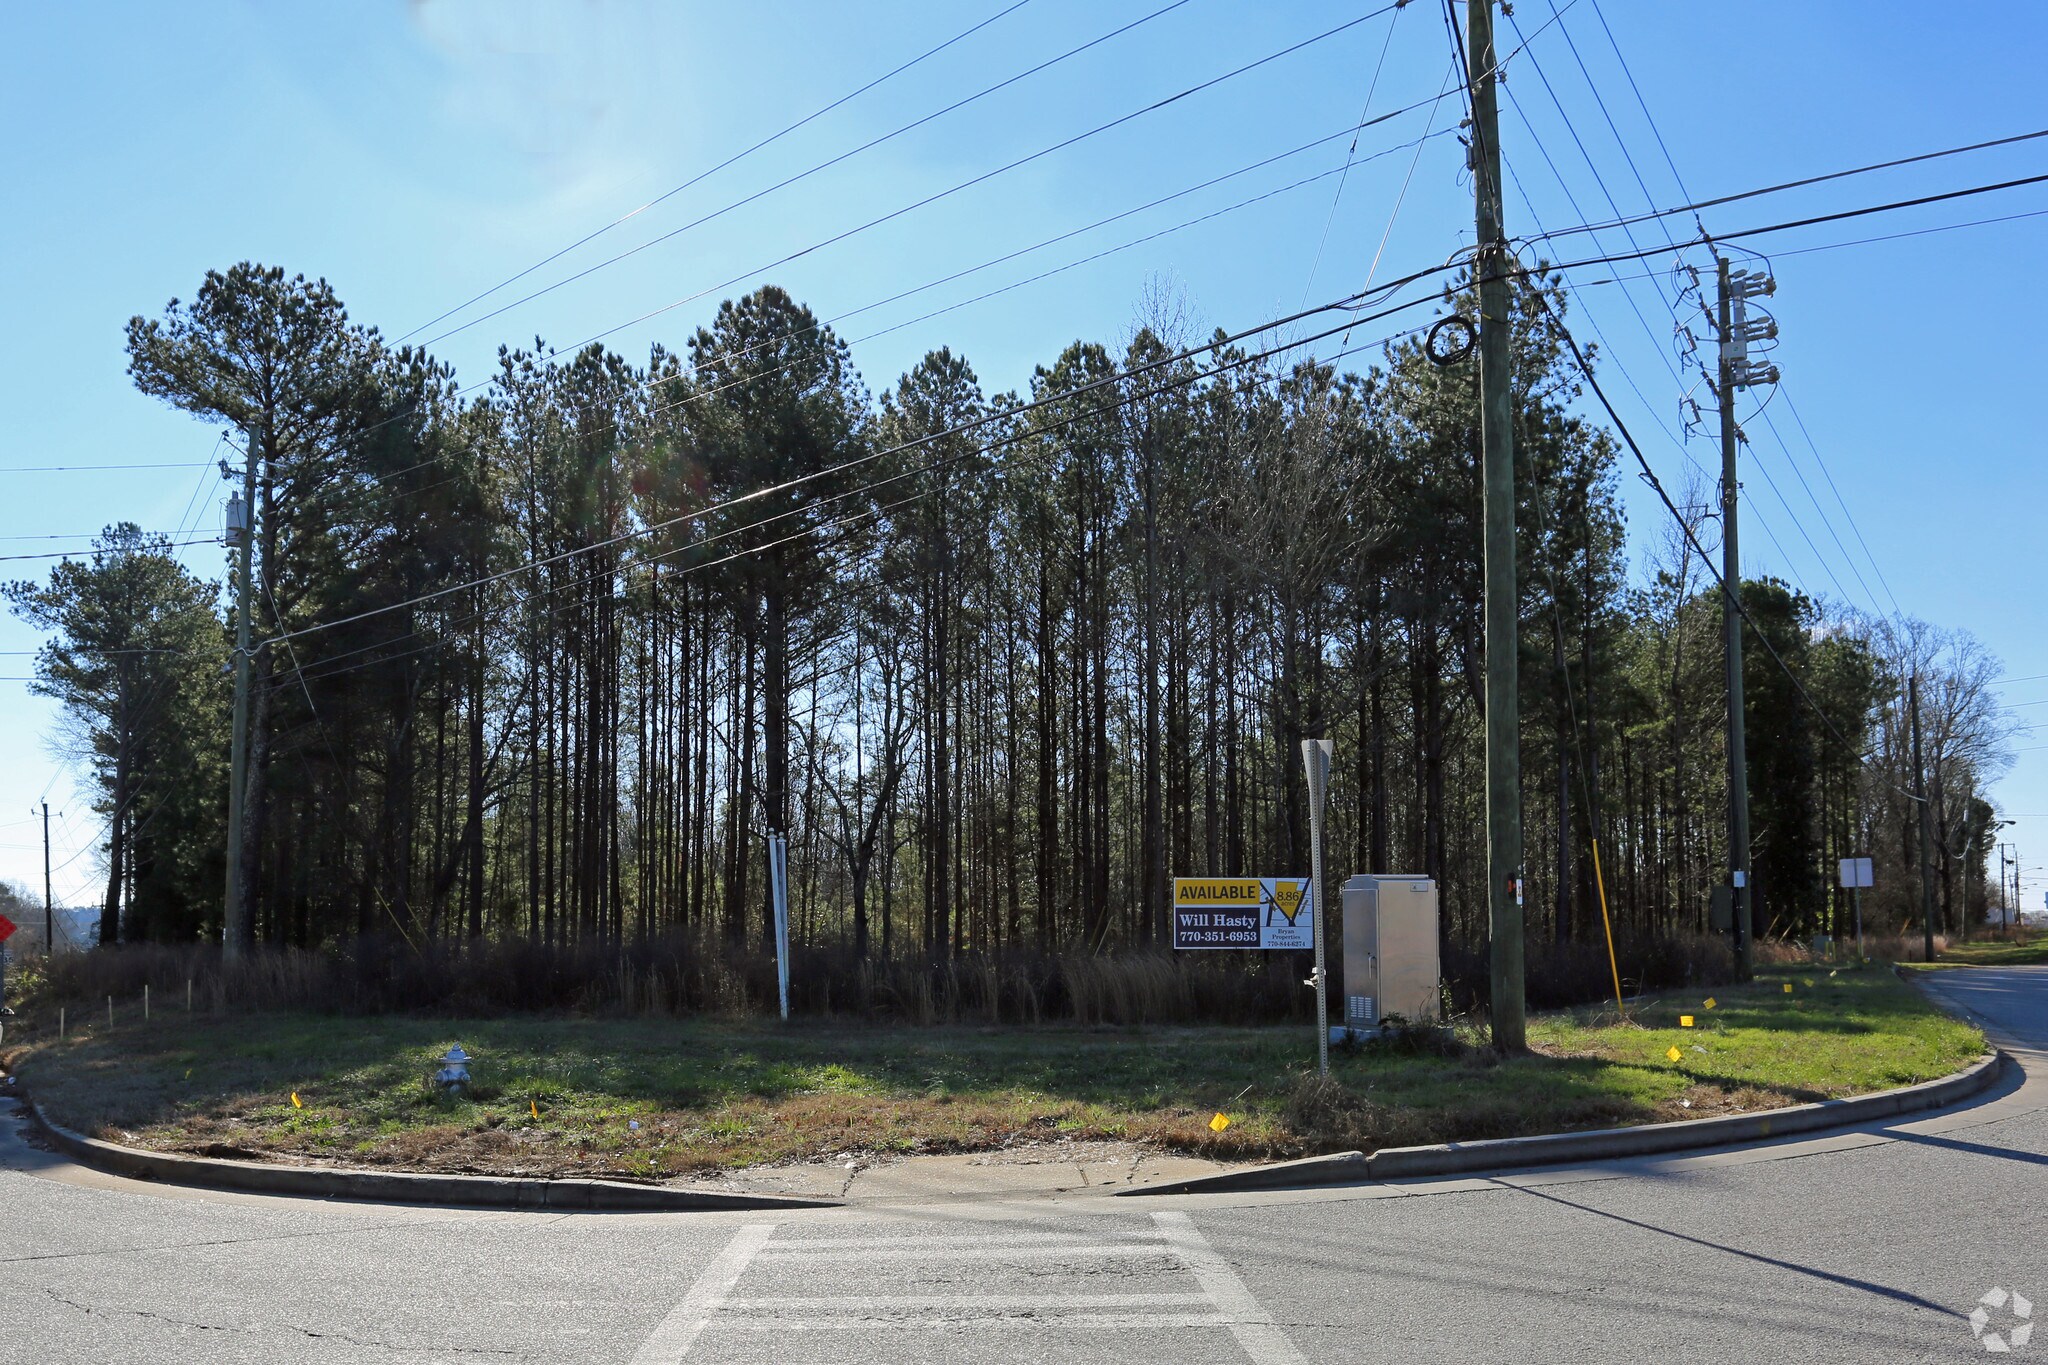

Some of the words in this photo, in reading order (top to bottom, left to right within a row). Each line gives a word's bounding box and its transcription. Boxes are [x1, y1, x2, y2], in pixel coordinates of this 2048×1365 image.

[1180, 886, 1256, 900] AVAILABLE
[1277, 891, 1299, 901] 8.86
[1179, 914, 1210, 927] Will
[1213, 914, 1257, 929] Hasty
[1180, 932, 1257, 942] 770-351-6953
